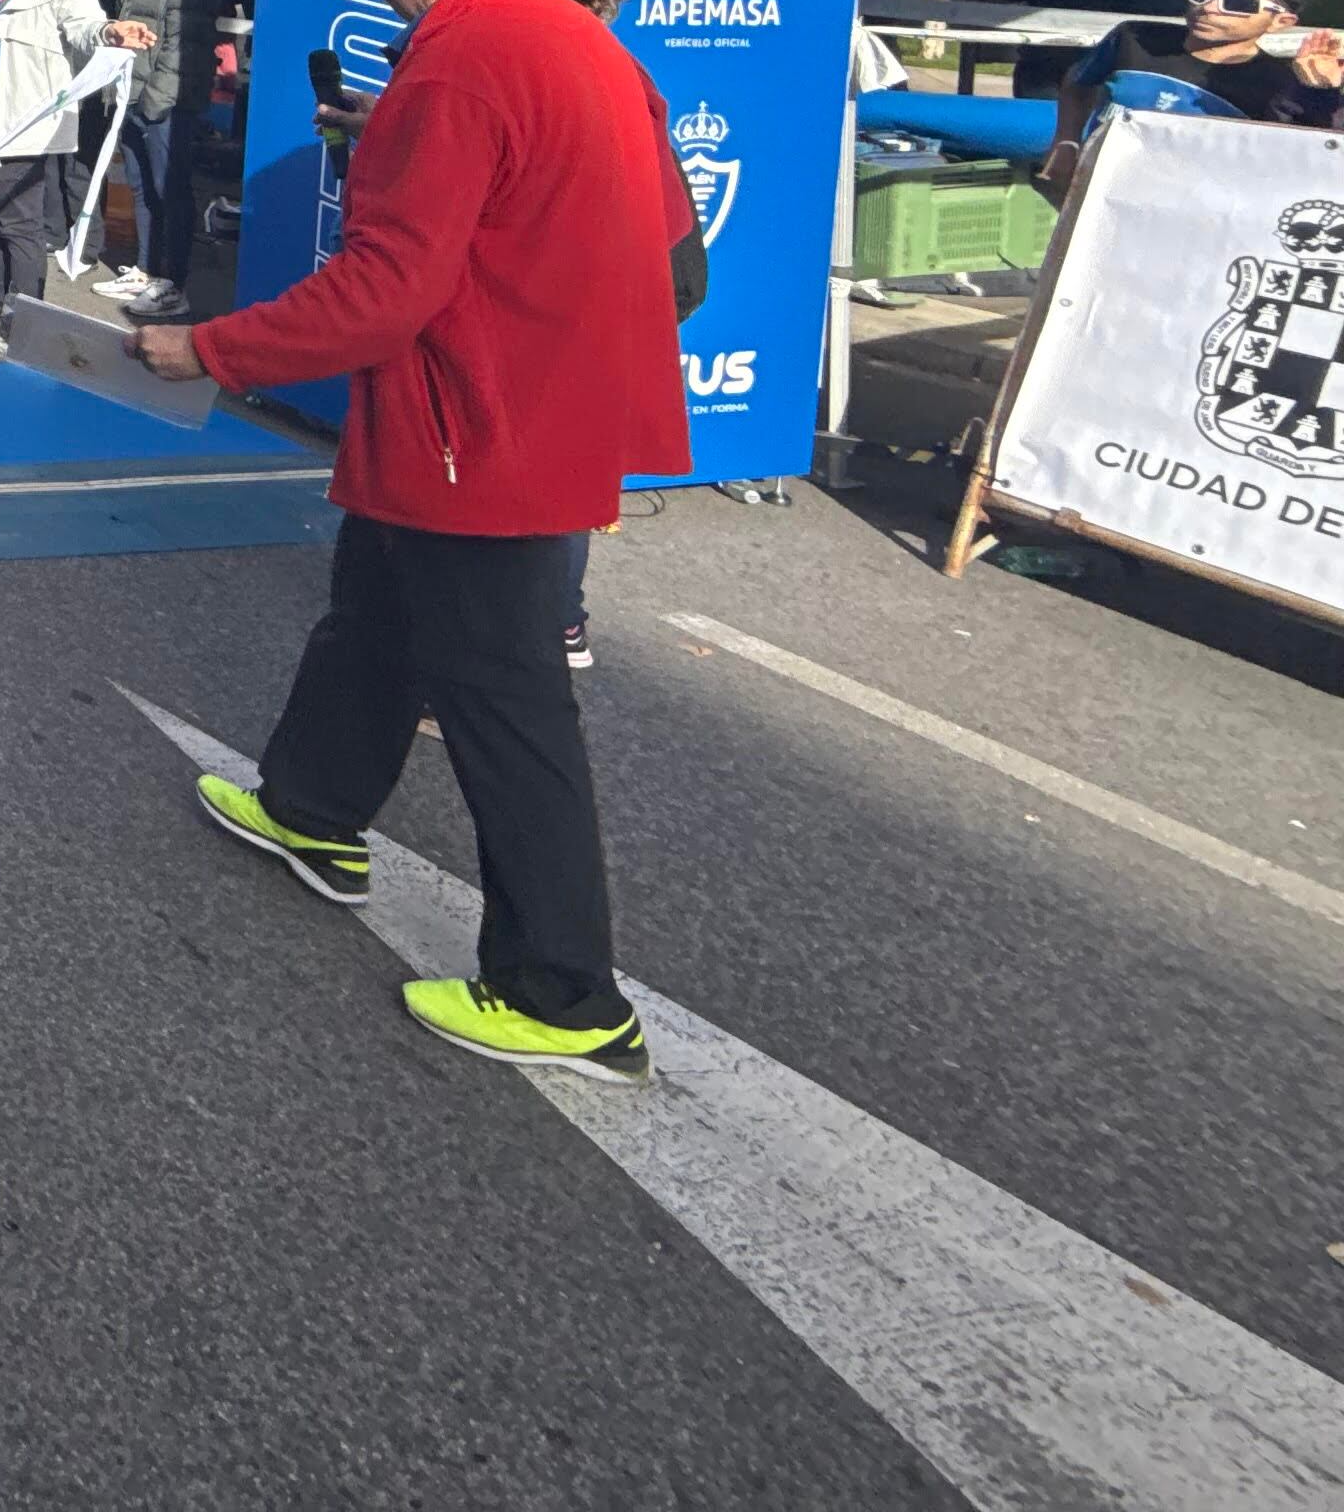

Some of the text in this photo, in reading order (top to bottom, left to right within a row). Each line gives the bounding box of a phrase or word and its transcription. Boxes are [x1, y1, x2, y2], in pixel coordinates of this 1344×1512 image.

[713, 38, 751, 49] OFICIAL
[693, 403, 749, 415] EN FORMA
[1095, 442, 1344, 538] CIUDAD DE
